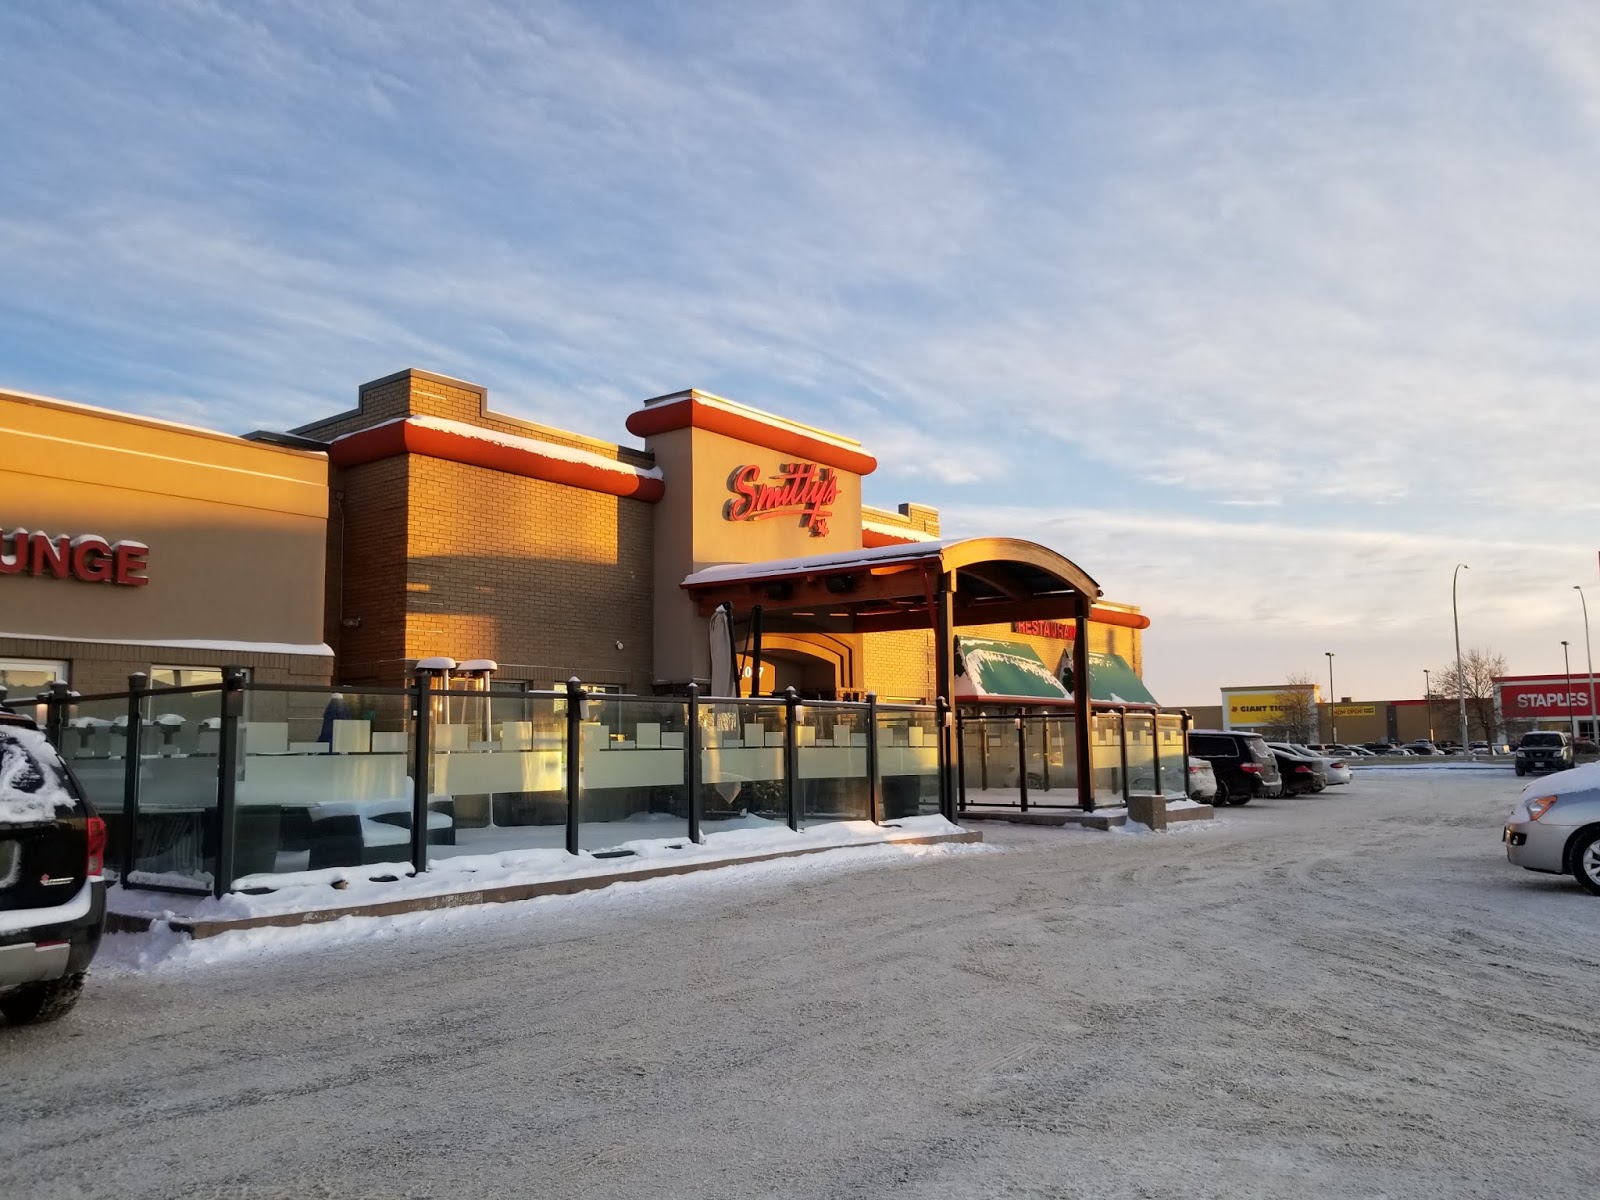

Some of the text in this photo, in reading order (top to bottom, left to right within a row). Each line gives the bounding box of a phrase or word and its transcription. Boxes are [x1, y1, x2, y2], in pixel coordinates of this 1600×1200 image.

[726, 463, 841, 528] Smitty's
[0, 527, 149, 586] UNGE
[1016, 619, 1076, 640] RESTAURAN
[1517, 692, 1589, 707] STAPLES
